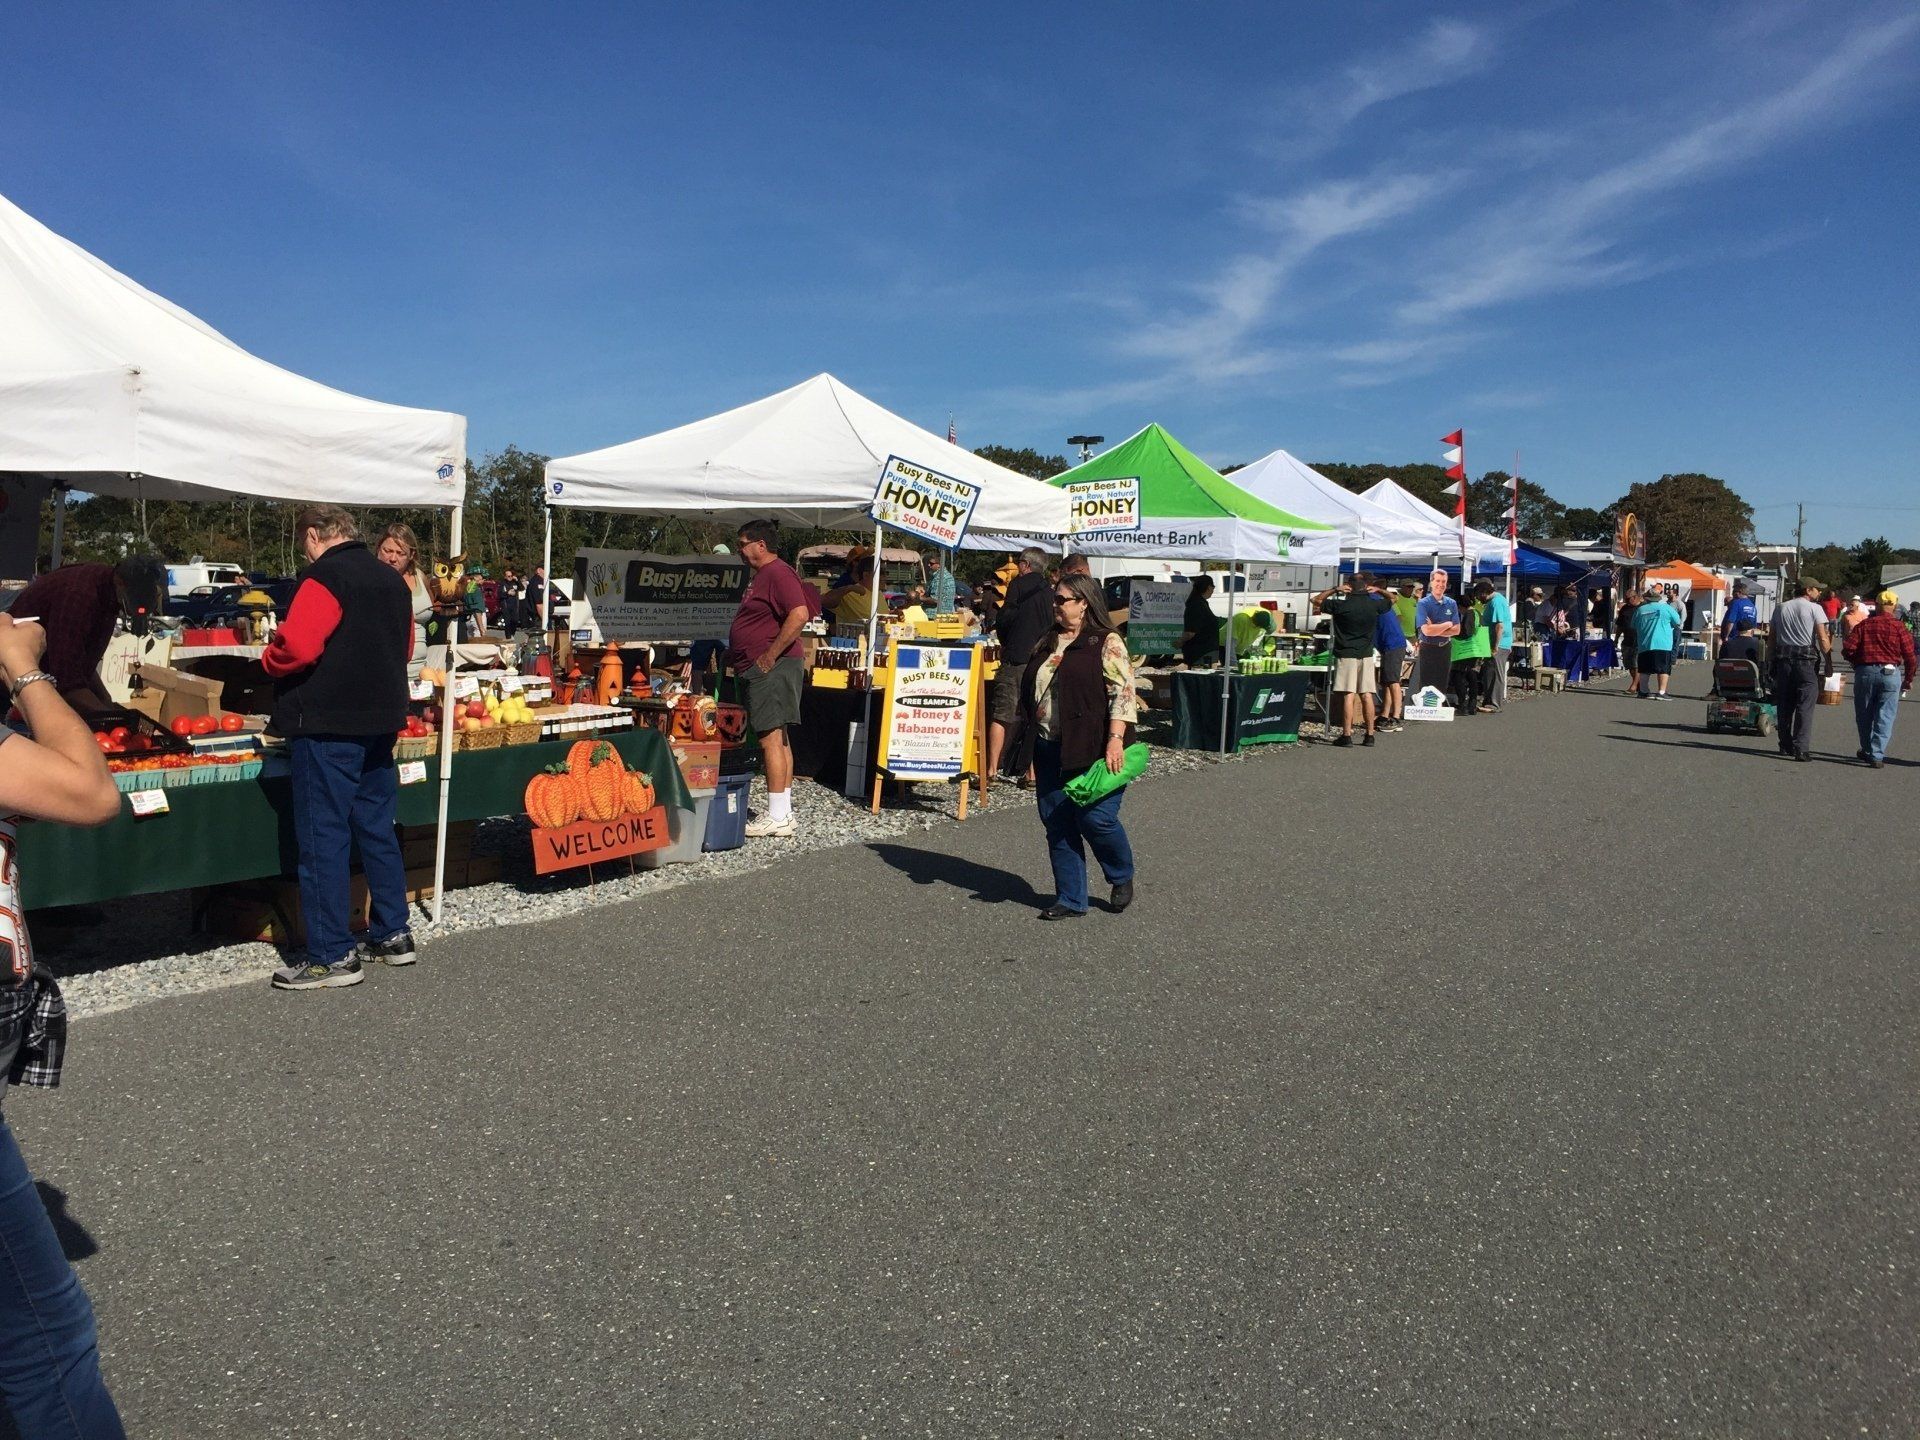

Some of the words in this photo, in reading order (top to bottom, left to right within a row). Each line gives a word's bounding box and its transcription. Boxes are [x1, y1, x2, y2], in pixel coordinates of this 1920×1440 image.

[896, 462, 922, 481] Busy
[926, 473, 952, 490] Bees
[955, 483, 971, 497] NJ
[1070, 485, 1090, 493] Busy
[1094, 482, 1116, 490] Bees
[1120, 480, 1132, 488] NJ
[886, 471, 908, 488] Pure,
[912, 481, 932, 496] Raw,
[936, 489, 970, 509] Natural
[1107, 490, 1136, 498] Natural
[884, 482, 966, 526] HONEY
[1071, 498, 1136, 517] HONEY
[902, 514, 928, 530] SOLD
[931, 524, 957, 540] HERE
[1088, 518, 1109, 526] SOLD
[1076, 531, 1163, 544] Convenient
[638, 567, 683, 592] Busy
[684, 569, 719, 588] Bees
[720, 570, 743, 588] NJ
[1146, 592, 1176, 602] COMFORT
[903, 672, 926, 684] BUSY
[929, 671, 950, 681] BEES
[952, 676, 964, 686] NJ
[912, 709, 950, 722] Honey
[953, 711, 963, 720] &
[897, 723, 959, 735] Habaneros
[889, 762, 960, 770] www.BusyBeesNJ.com
[549, 818, 655, 860] WELCOME
